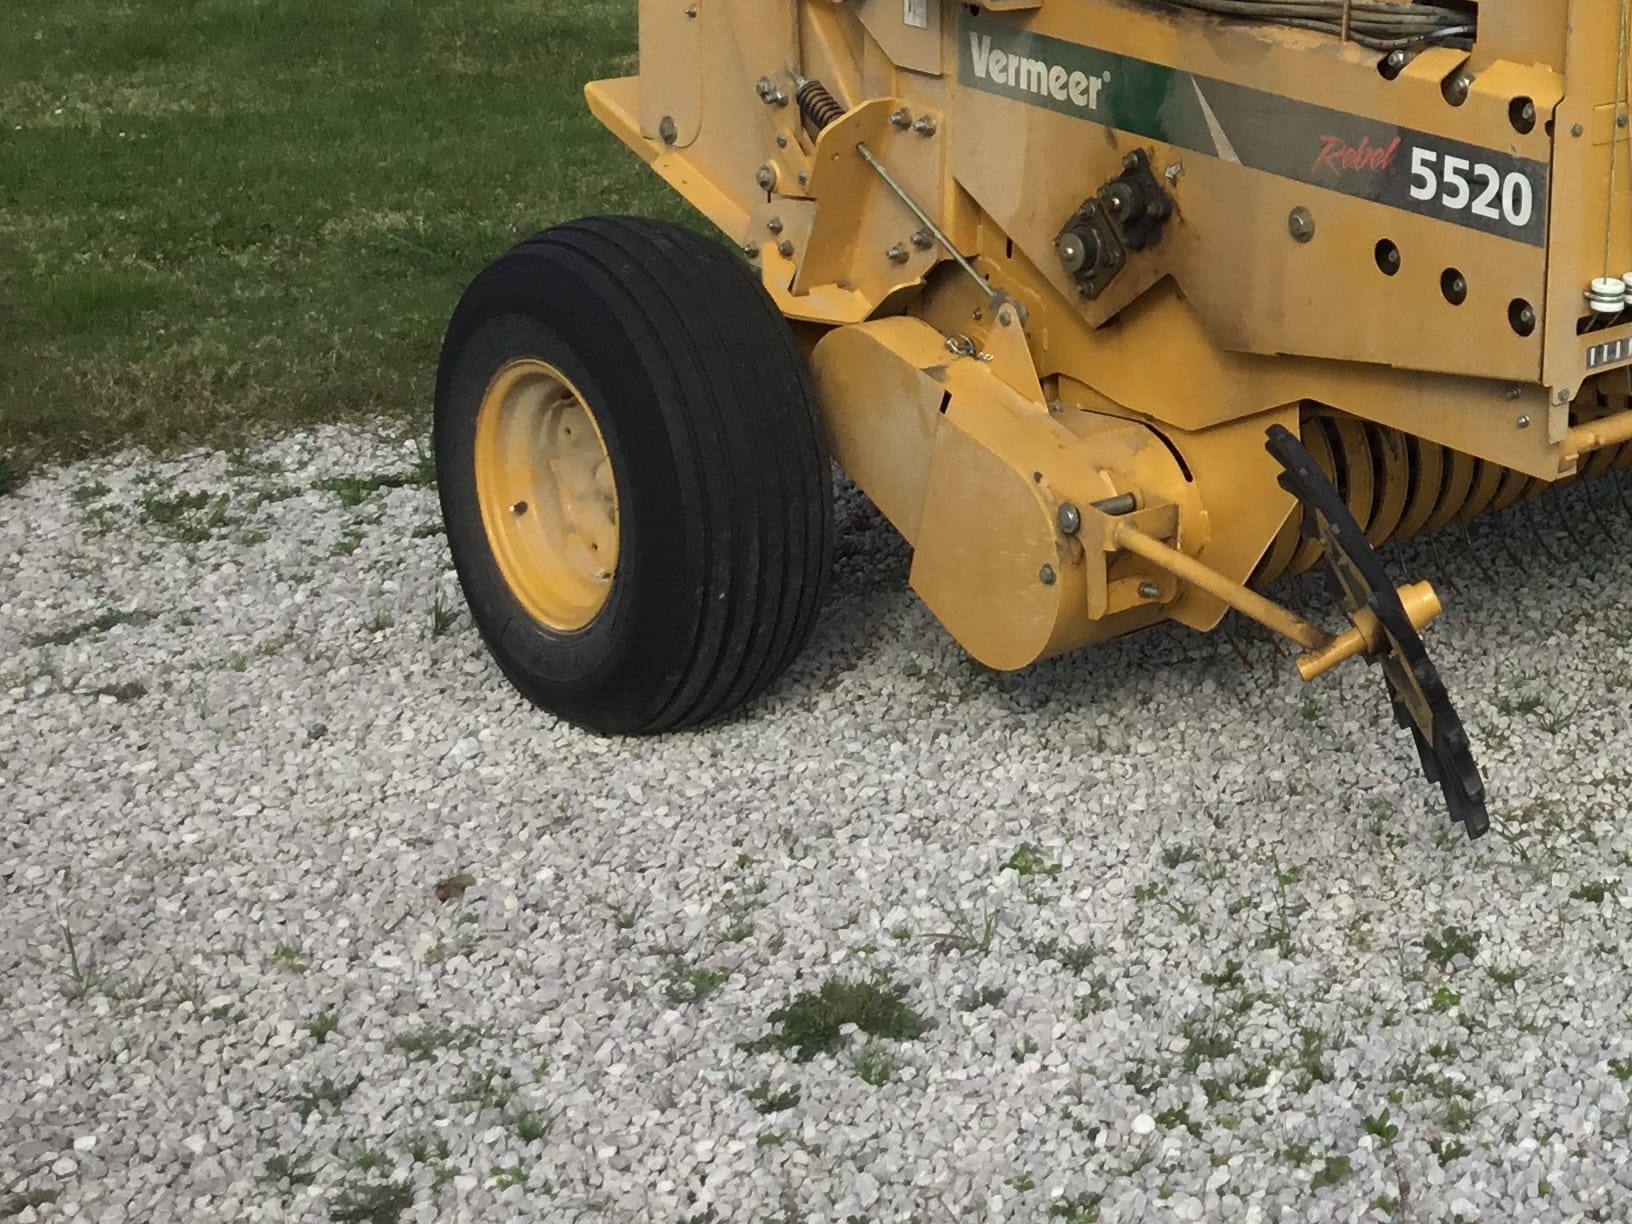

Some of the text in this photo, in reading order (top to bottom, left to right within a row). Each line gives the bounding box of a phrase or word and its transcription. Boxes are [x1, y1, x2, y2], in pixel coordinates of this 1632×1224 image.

[969, 31, 1533, 227] Vermeer Rebel 5520
